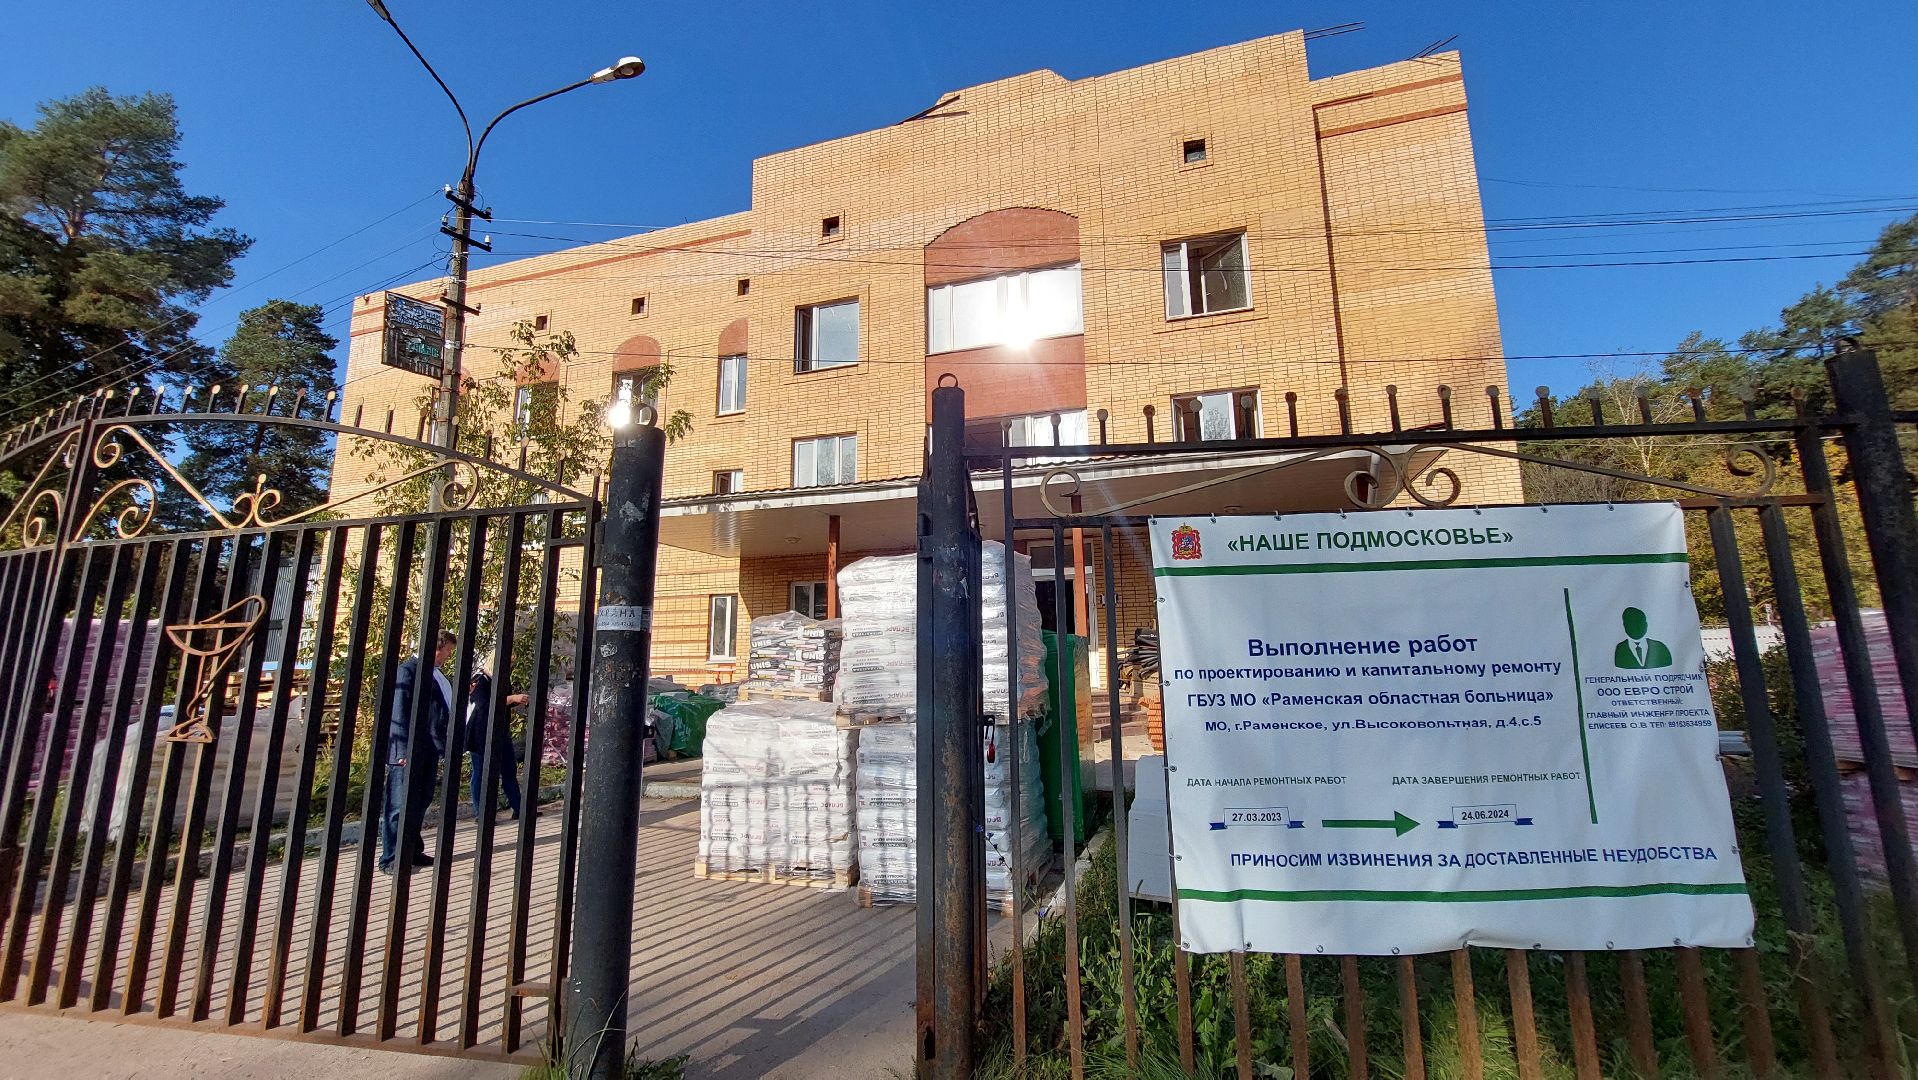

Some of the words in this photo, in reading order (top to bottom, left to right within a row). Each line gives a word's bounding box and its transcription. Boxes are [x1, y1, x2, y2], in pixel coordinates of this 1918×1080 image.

[1228, 533, 1309, 551] «НАШЕ
[1317, 528, 1513, 551] ПОДМОСКОВЬЕ»
[751, 640, 772, 648] UNIS
[1249, 639, 1400, 656] Выполнение
[1408, 634, 1477, 657] работ
[750, 661, 771, 669] UNIS
[1175, 670, 1193, 679] по
[1199, 667, 1340, 682] проектированию
[1346, 667, 1356, 676] и
[1362, 664, 1485, 679] капитальному
[1492, 662, 1561, 677] ремонту
[1585, 674, 1651, 684] ГЕНЕРАЛЬНЫЙ
[1654, 673, 1703, 682] ПОДРЯДЧИК
[1597, 688, 1620, 696] ООО
[1624, 687, 1660, 695] ЕВРО
[1663, 684, 1693, 694] СТРОЙ
[1188, 694, 1225, 706] ГБУЗ
[1231, 693, 1256, 706] МО
[1262, 693, 1362, 705] «Раменская
[1369, 692, 1460, 704] областная
[1465, 690, 1553, 703] больница»
[1587, 710, 1628, 718] ГЛАВНЫЙ
[1206, 721, 1230, 732] МО,
[1235, 721, 1327, 730] г.Раменское,
[1332, 720, 1491, 731] ул.Высоковольтная,
[1187, 778, 1212, 787] ДАТА
[1215, 778, 1251, 786] НАЧАЛА
[1254, 777, 1312, 785] РЕМОНТНЫХ
[1392, 777, 1419, 785] ДАТА
[1422, 776, 1488, 784] ЗАВЕРШЕНИЯ
[1491, 773, 1548, 782] РЕМОНТНЫХ
[1551, 772, 1580, 780] РАБОТ
[1231, 812, 1282, 822] 27.03.2023
[1461, 810, 1509, 820] 24.06.2024
[1231, 854, 1322, 867] ПРИНОСИМ
[1328, 854, 1432, 867] ИЗВИНЕНИЯ
[1438, 854, 1461, 867] ЗА
[1465, 849, 1598, 868] ДОСТАВЛЕННЫЕ
[1603, 847, 1717, 864] НЕУДОБСТВА
